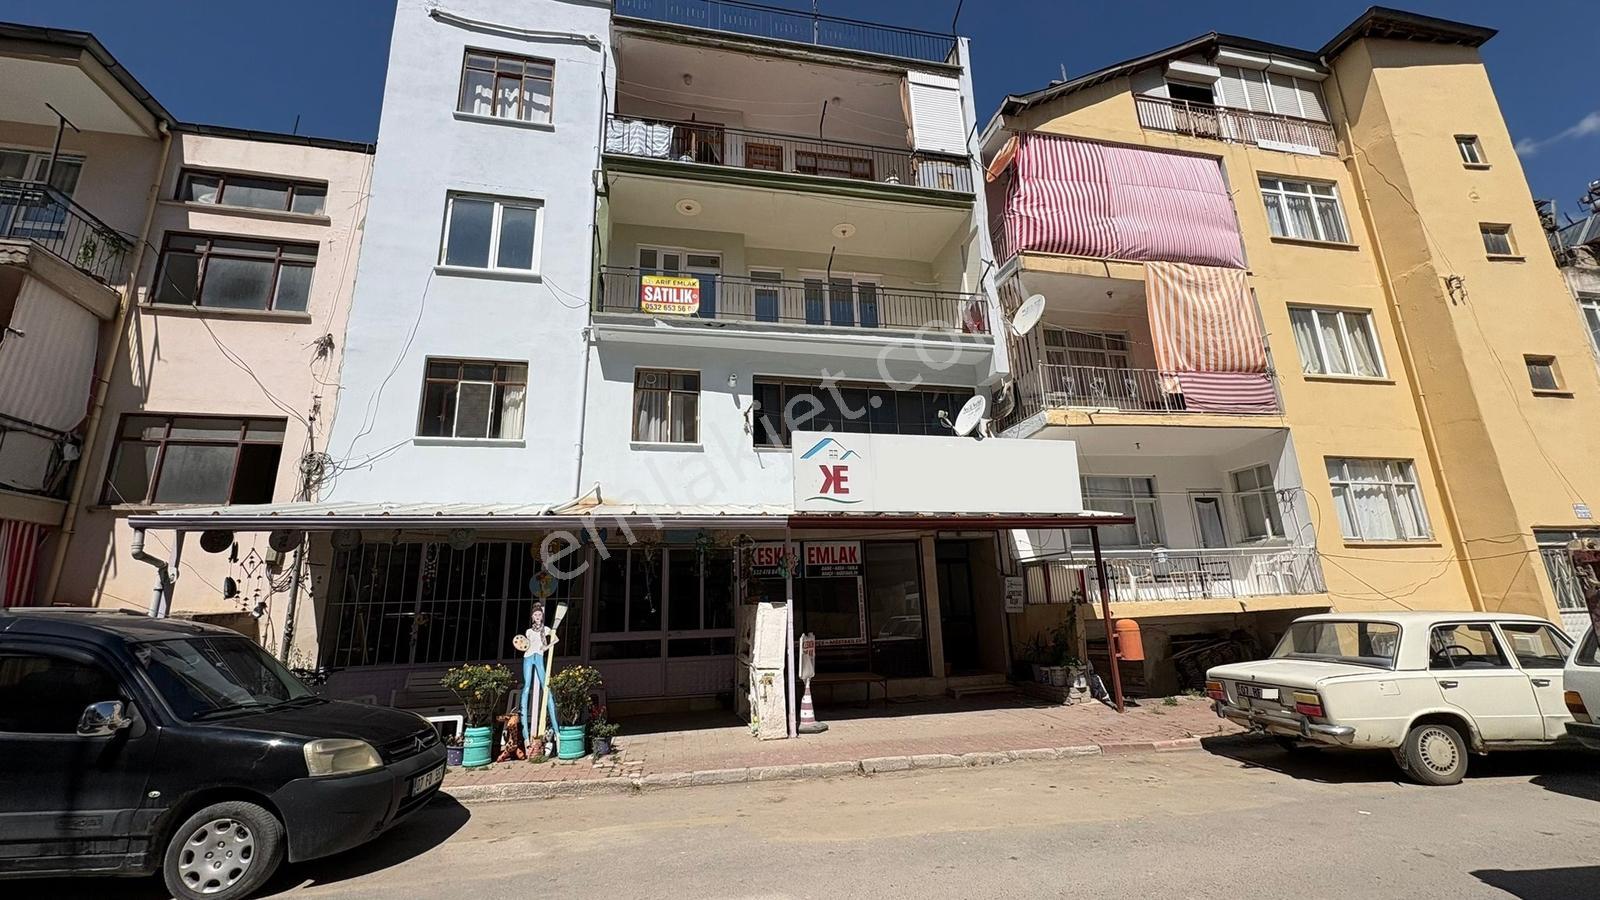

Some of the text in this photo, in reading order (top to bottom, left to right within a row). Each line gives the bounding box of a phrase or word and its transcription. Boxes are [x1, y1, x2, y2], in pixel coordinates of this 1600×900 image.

[673, 279, 697, 287] EMLAK
[644, 286, 693, 303] SATILIK
[645, 303, 662, 311] 0532
[807, 546, 858, 564] EMLAK
